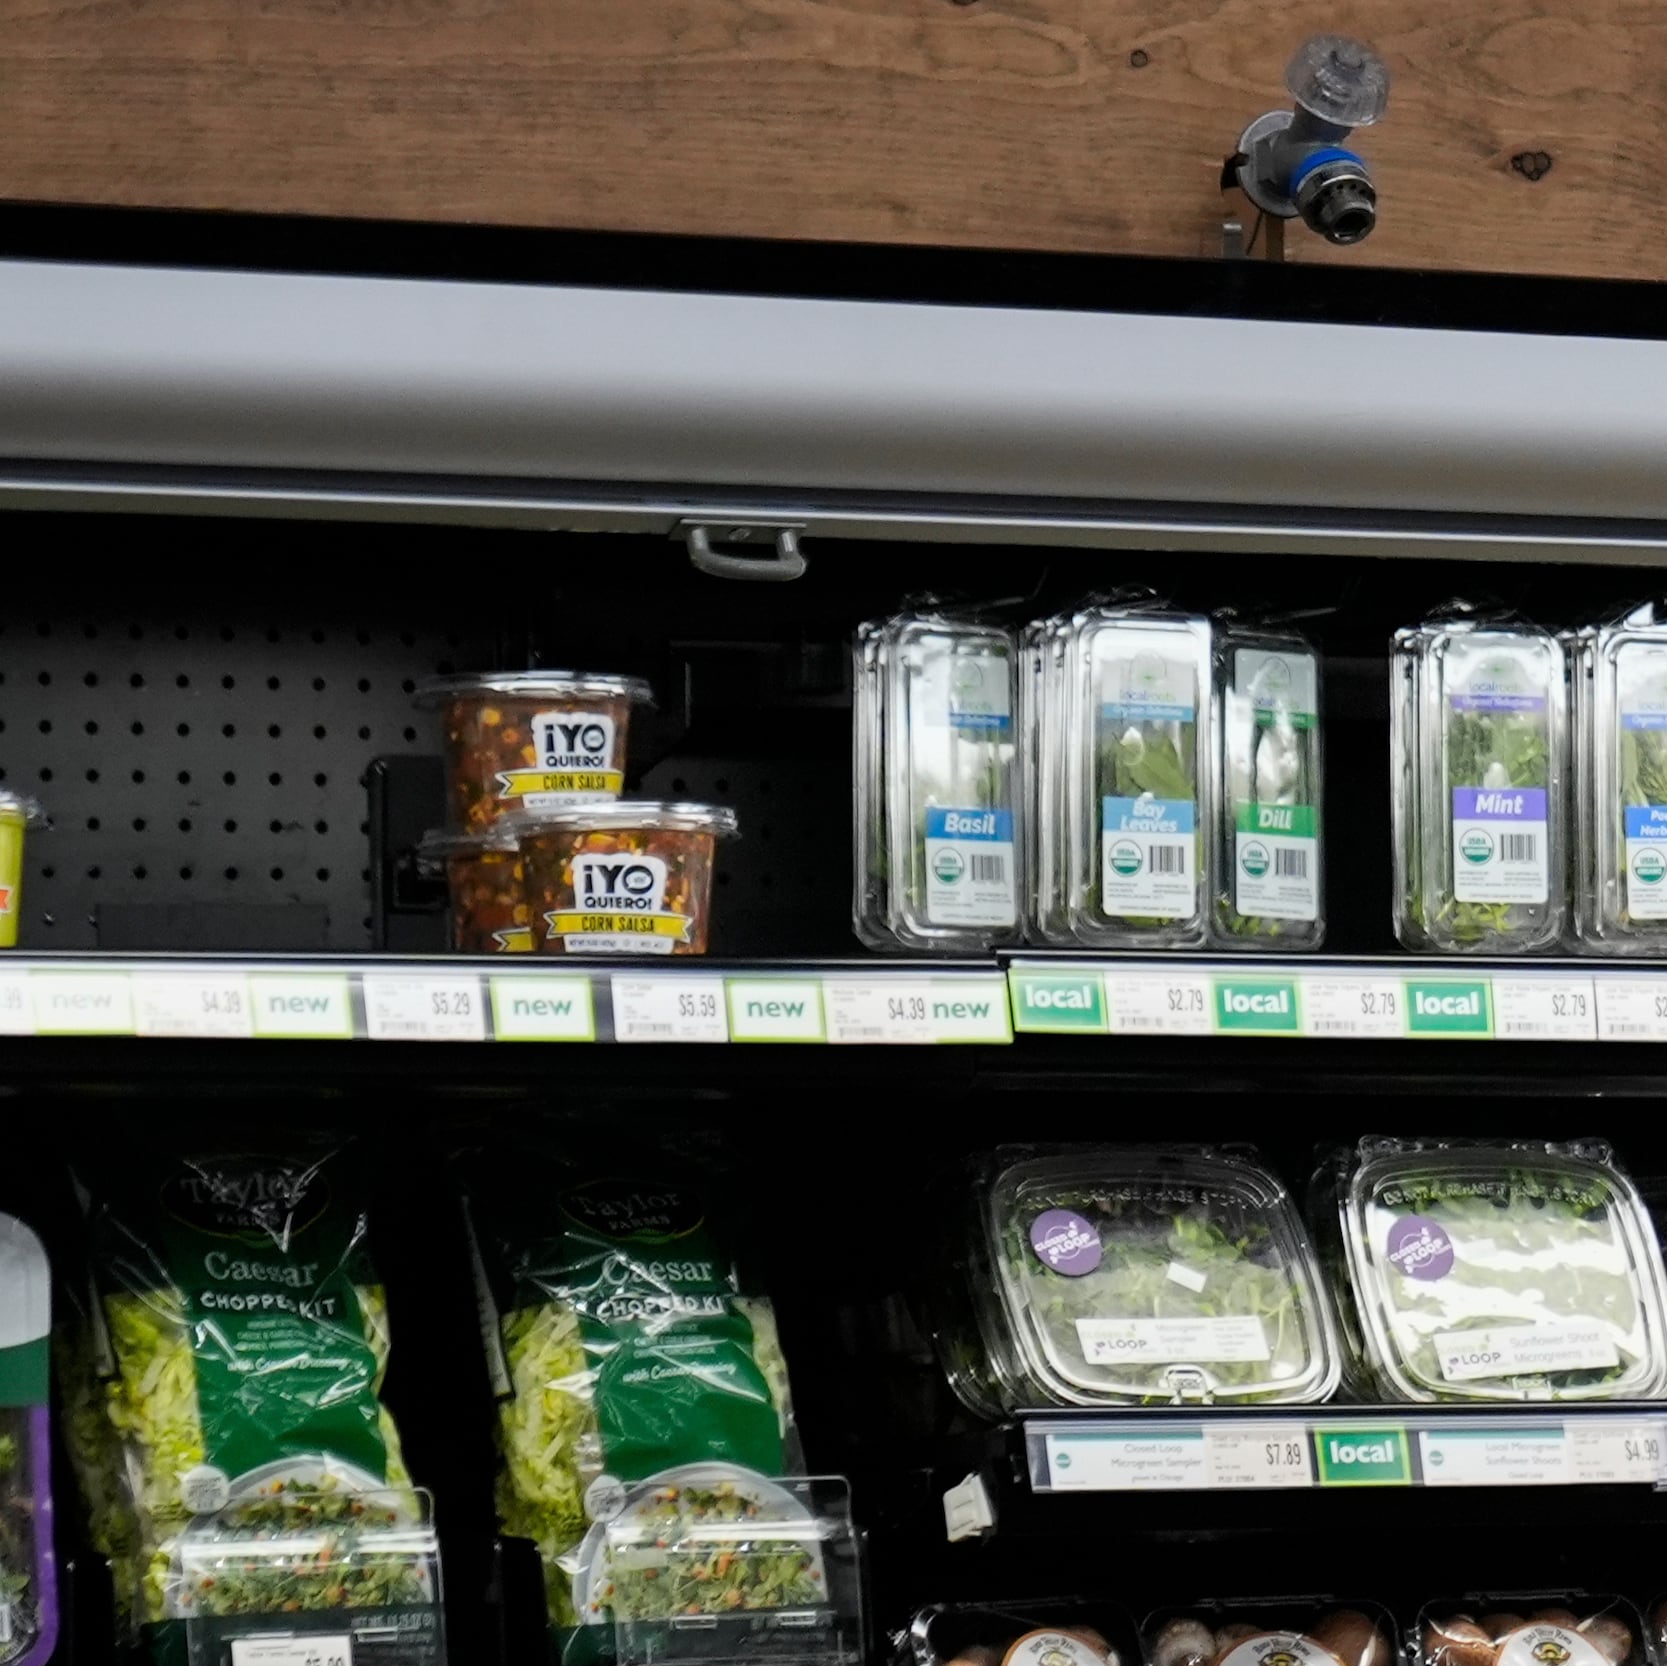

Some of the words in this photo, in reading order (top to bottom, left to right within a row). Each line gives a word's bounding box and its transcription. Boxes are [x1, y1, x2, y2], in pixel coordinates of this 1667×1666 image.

[543, 775, 575, 791] CORN
[578, 776, 607, 791] SALSA
[1132, 801, 1166, 819] Bay
[1475, 792, 1523, 815] Mint
[943, 814, 996, 834] Basil
[1119, 816, 1178, 834] Leaves
[1259, 811, 1292, 829] Dill
[1640, 824, 1667, 837] Herb
[584, 896, 652, 910] QUIERO!
[582, 916, 614, 932] CORN
[617, 918, 655, 933] SALSA
[268, 993, 329, 1013] new
[430, 992, 470, 1016] $5.29
[512, 997, 573, 1017] new
[678, 994, 717, 1017] $5.59
[746, 999, 806, 1019] new
[888, 997, 926, 1021] $4.39
[934, 1002, 989, 1019] new
[1024, 984, 1093, 1010] local
[1167, 987, 1204, 1012] $2.79
[1223, 988, 1290, 1014] local
[1360, 991, 1396, 1016] $2.79
[1415, 991, 1480, 1016] local
[1551, 993, 1587, 1018] $2.79
[1059, 1233, 1091, 1254] LOOP
[203, 1250, 319, 1288] Caesar
[601, 1257, 714, 1284] Caesar
[1108, 1339, 1148, 1350] LOOP
[1460, 1353, 1501, 1365] LOOP
[1159, 1443, 1183, 1455] Loop
[1265, 1443, 1302, 1466] $7.89
[1329, 1440, 1394, 1466] local
[1510, 1440, 1561, 1453] Microgreen
[1624, 1439, 1660, 1463] $4.99
[1110, 1458, 1160, 1470] Microgreen
[1485, 1455, 1529, 1466] Sunflower
[1530, 1455, 1562, 1466] Shoots
